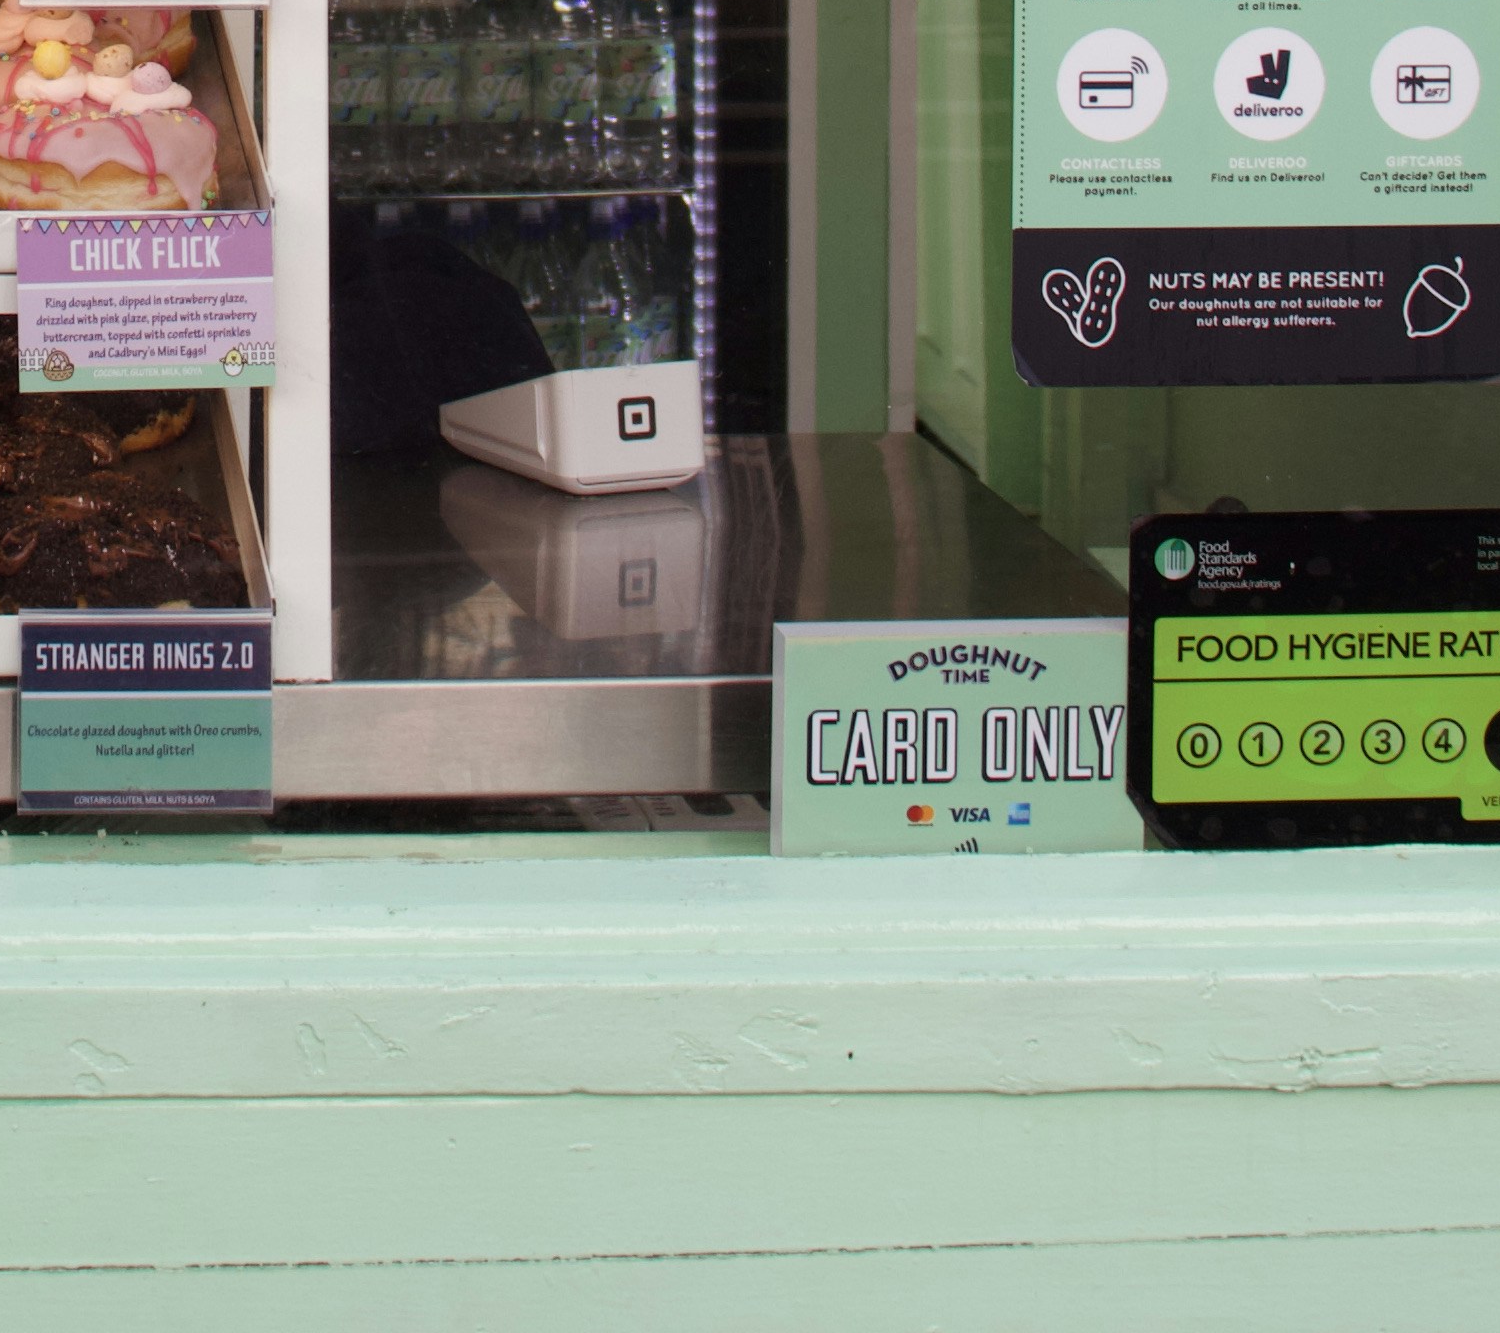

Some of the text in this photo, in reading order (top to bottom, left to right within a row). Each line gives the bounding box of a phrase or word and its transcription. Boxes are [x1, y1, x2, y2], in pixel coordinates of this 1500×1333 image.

[1237, 1, 1301, 11] at all times.
[1423, 88, 1444, 97] GIFT
[1233, 103, 1304, 117] deliveroo
[1060, 157, 1161, 170] CONTACTLESS
[1228, 155, 1307, 169] DELIVEROO
[1385, 154, 1462, 167] GIFTCARDS
[1049, 173, 1172, 183] Please use contactless
[1210, 171, 1325, 182] Find us on Deliveroo!
[1359, 170, 1487, 181] Can't decide? Get them
[1084, 185, 1137, 197] payment.
[1373, 182, 1473, 195] a giftcard instead!
[70, 235, 220, 271] CHICK FLICK
[1148, 270, 1383, 289] NUTS MAY BE PRESENT!
[1148, 295, 1383, 312] Our doughnuts are not suitable for
[1195, 313, 1336, 329] nut allergy sufferers.
[1198, 539, 1230, 553] Food
[1198, 551, 1258, 565] Standards
[1197, 564, 1244, 579] Agency
[1177, 633, 1278, 663] FOOD
[1288, 631, 1430, 661] HYGIENE
[35, 641, 253, 670] STRANGER RINGS 2.0
[887, 643, 1048, 684] DOUGHNUT
[941, 668, 992, 685] TIME
[805, 704, 1126, 787] CARD ONLY
[1190, 733, 1209, 757] 0
[1253, 732, 1266, 757] 1
[1313, 731, 1332, 756] 2
[1374, 730, 1392, 754] 3
[1434, 728, 1454, 753] 4
[948, 807, 991, 823] VISA
